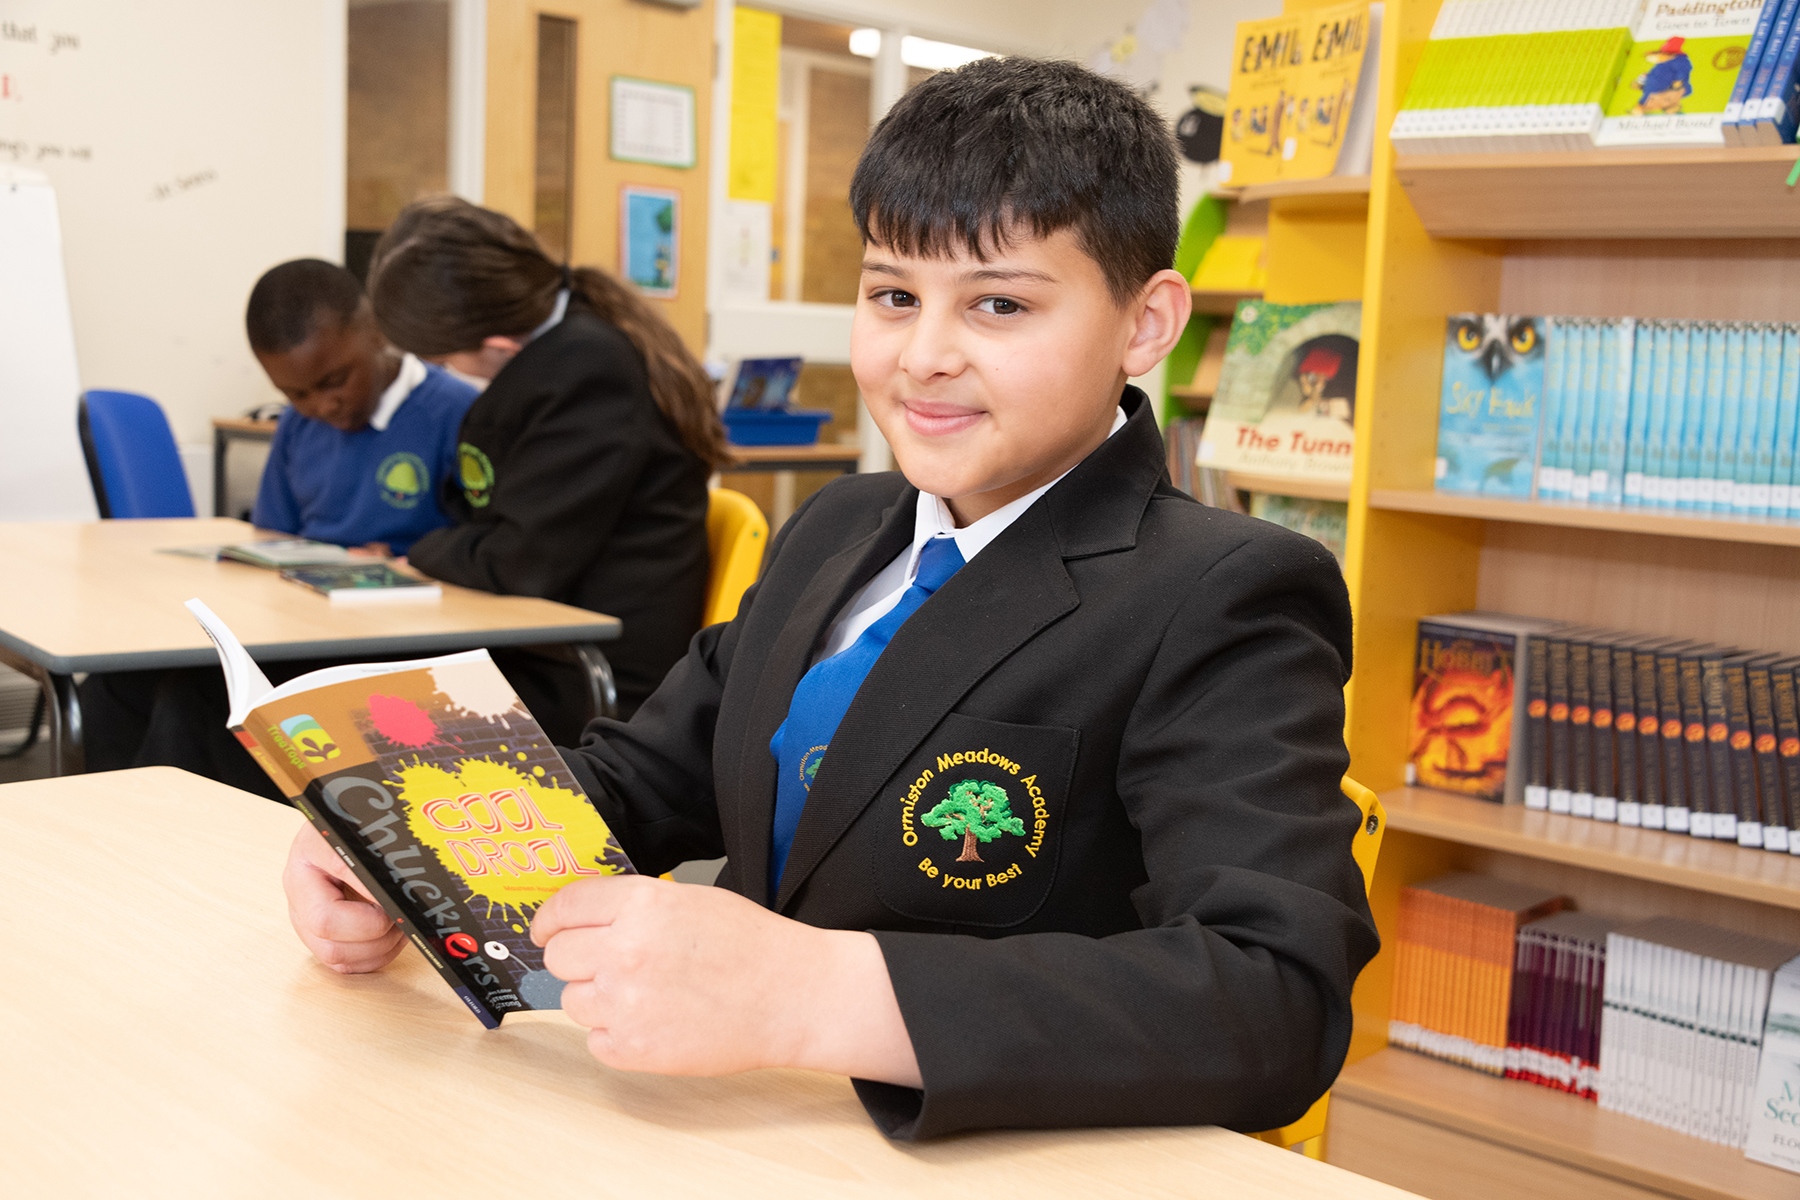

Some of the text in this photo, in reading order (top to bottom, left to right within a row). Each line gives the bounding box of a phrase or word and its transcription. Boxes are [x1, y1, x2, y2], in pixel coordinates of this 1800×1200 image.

[1239, 28, 1303, 74] EMIL
[1236, 426, 1280, 452] The
[421, 787, 565, 835] COOL
[900, 748, 1050, 858] Ormiston Meadows Academy
[444, 834, 601, 878] DROOL
[918, 857, 1022, 890] Be your Best
[321, 776, 499, 986] Chucklers
